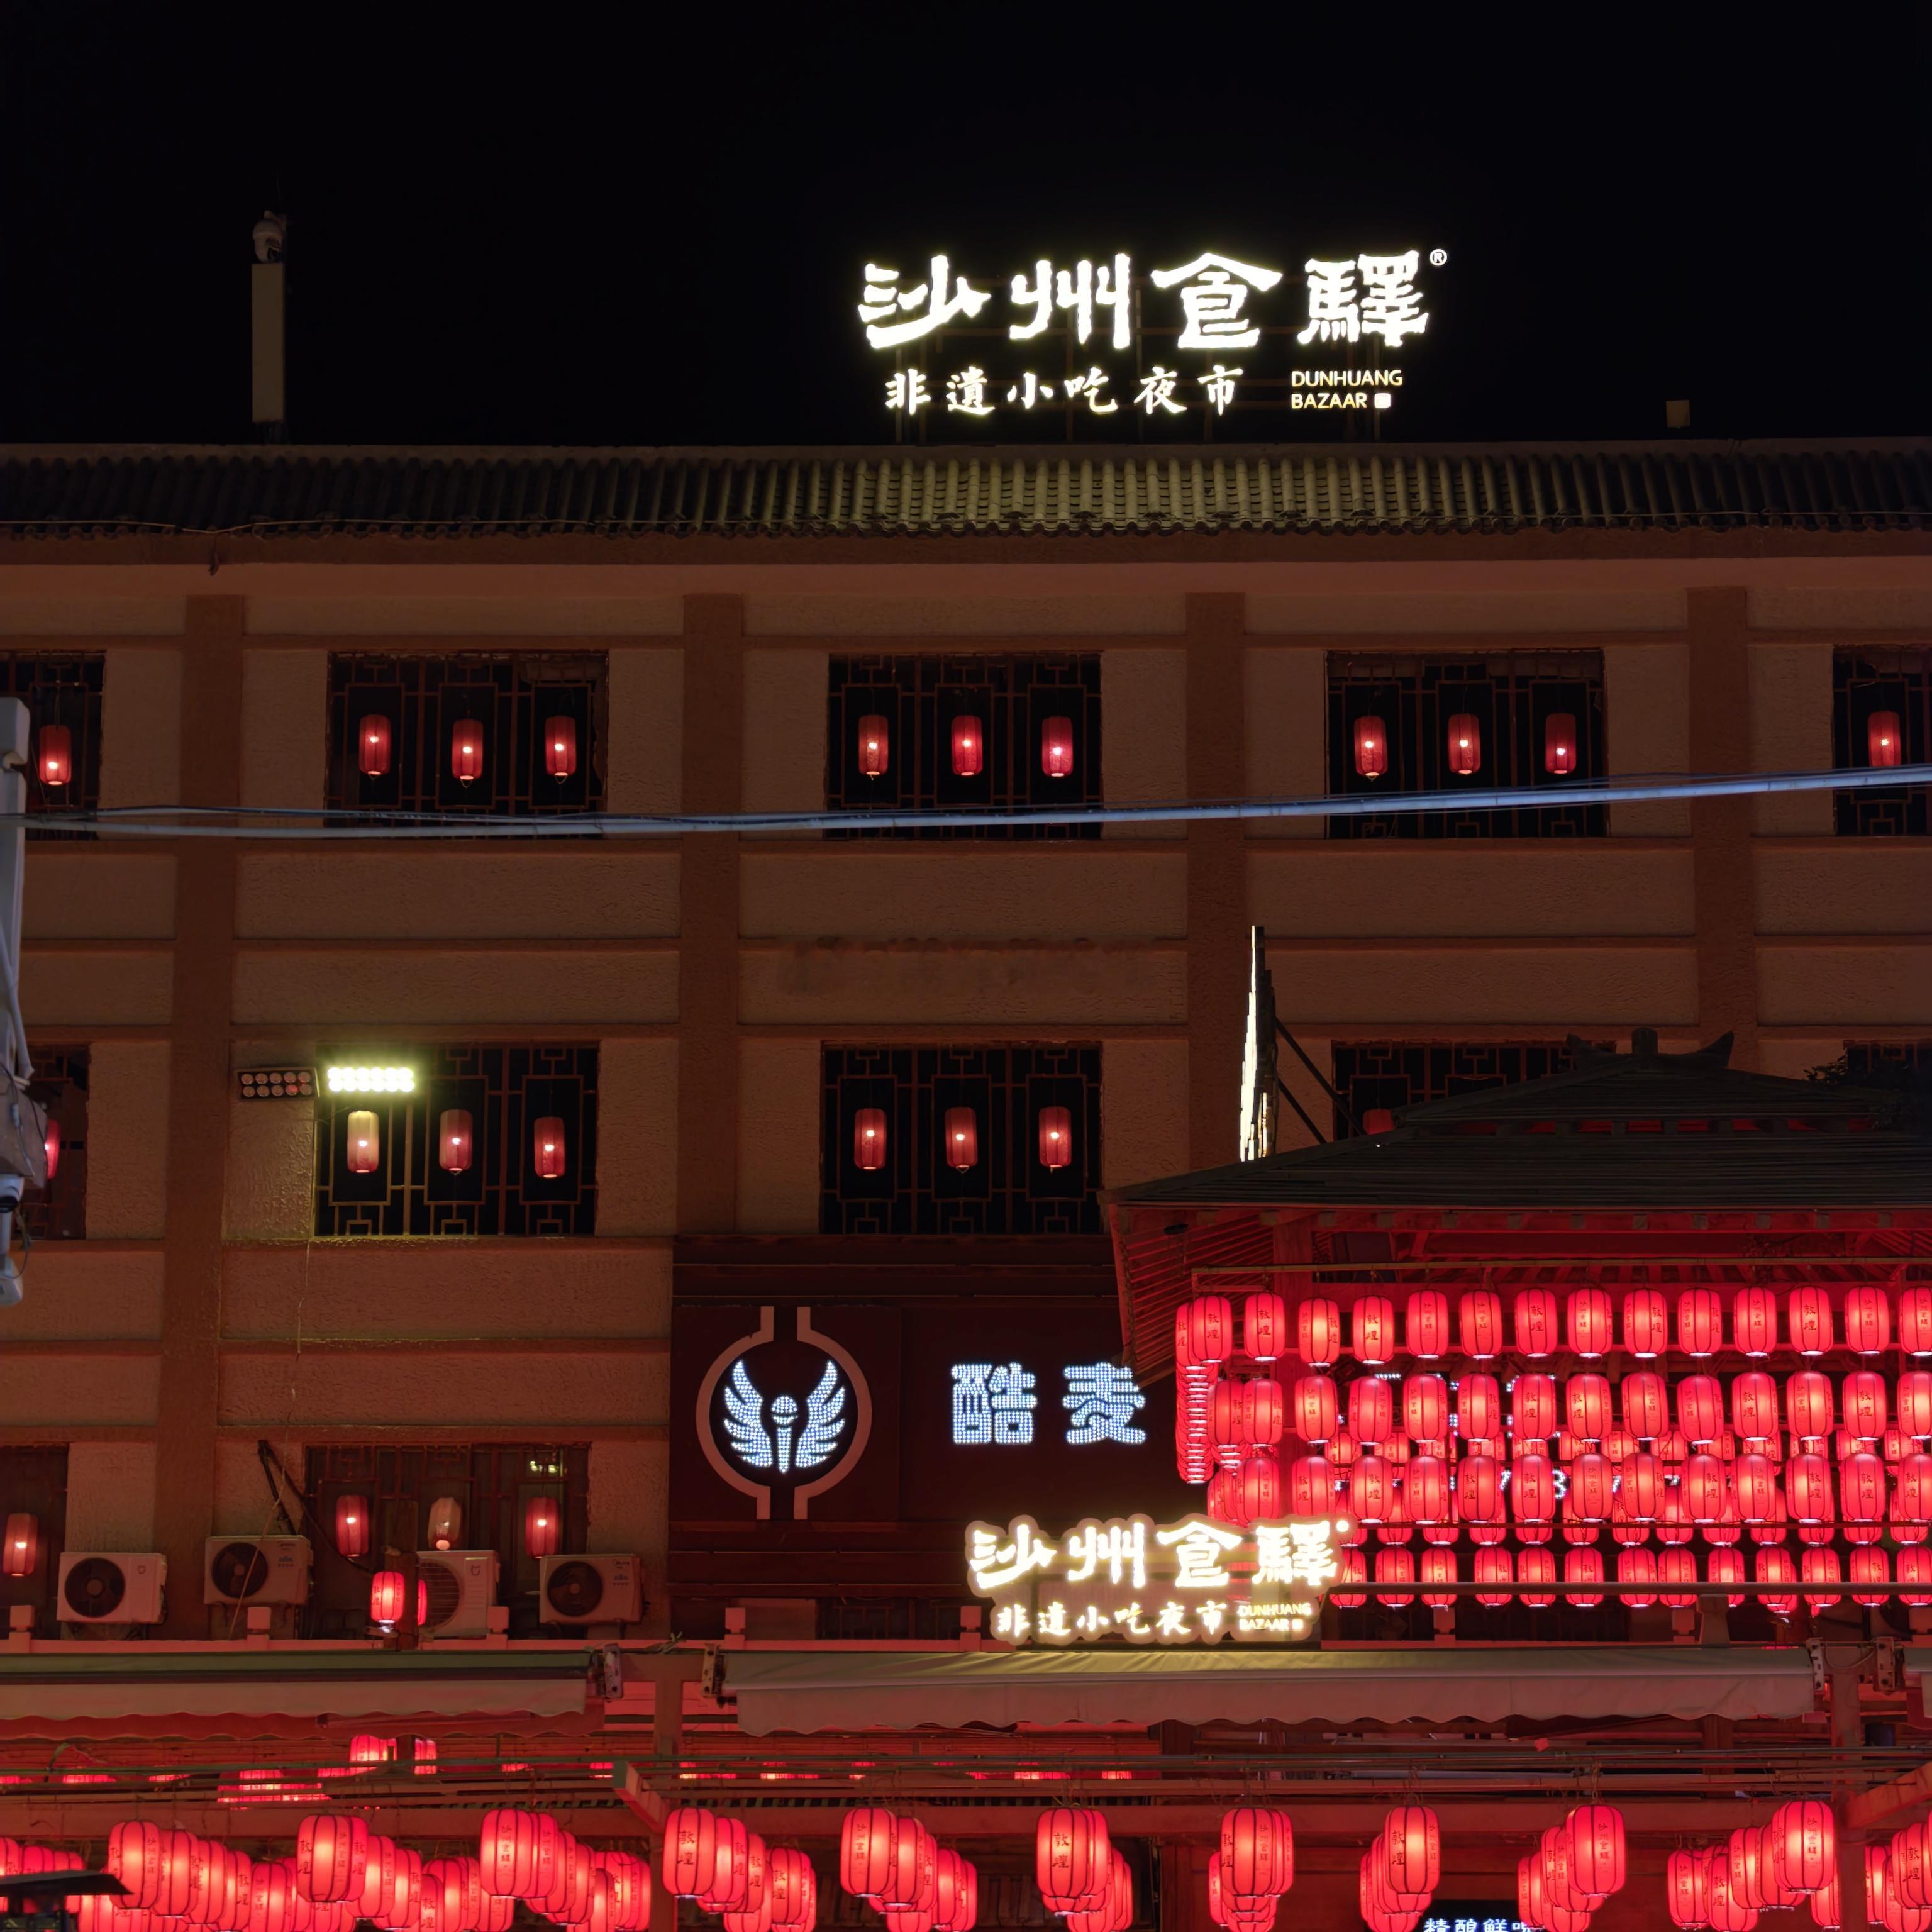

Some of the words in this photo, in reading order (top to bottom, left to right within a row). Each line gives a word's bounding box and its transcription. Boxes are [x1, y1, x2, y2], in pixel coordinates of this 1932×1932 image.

[1291, 369, 1403, 387] DUNHUANG
[885, 364, 1243, 416] 非遺小吃夜市
[1291, 392, 1368, 409] BAZAAR
[1238, 1602, 1312, 1616] DUNHUANG
[1239, 1619, 1289, 1631] BAZAAR
